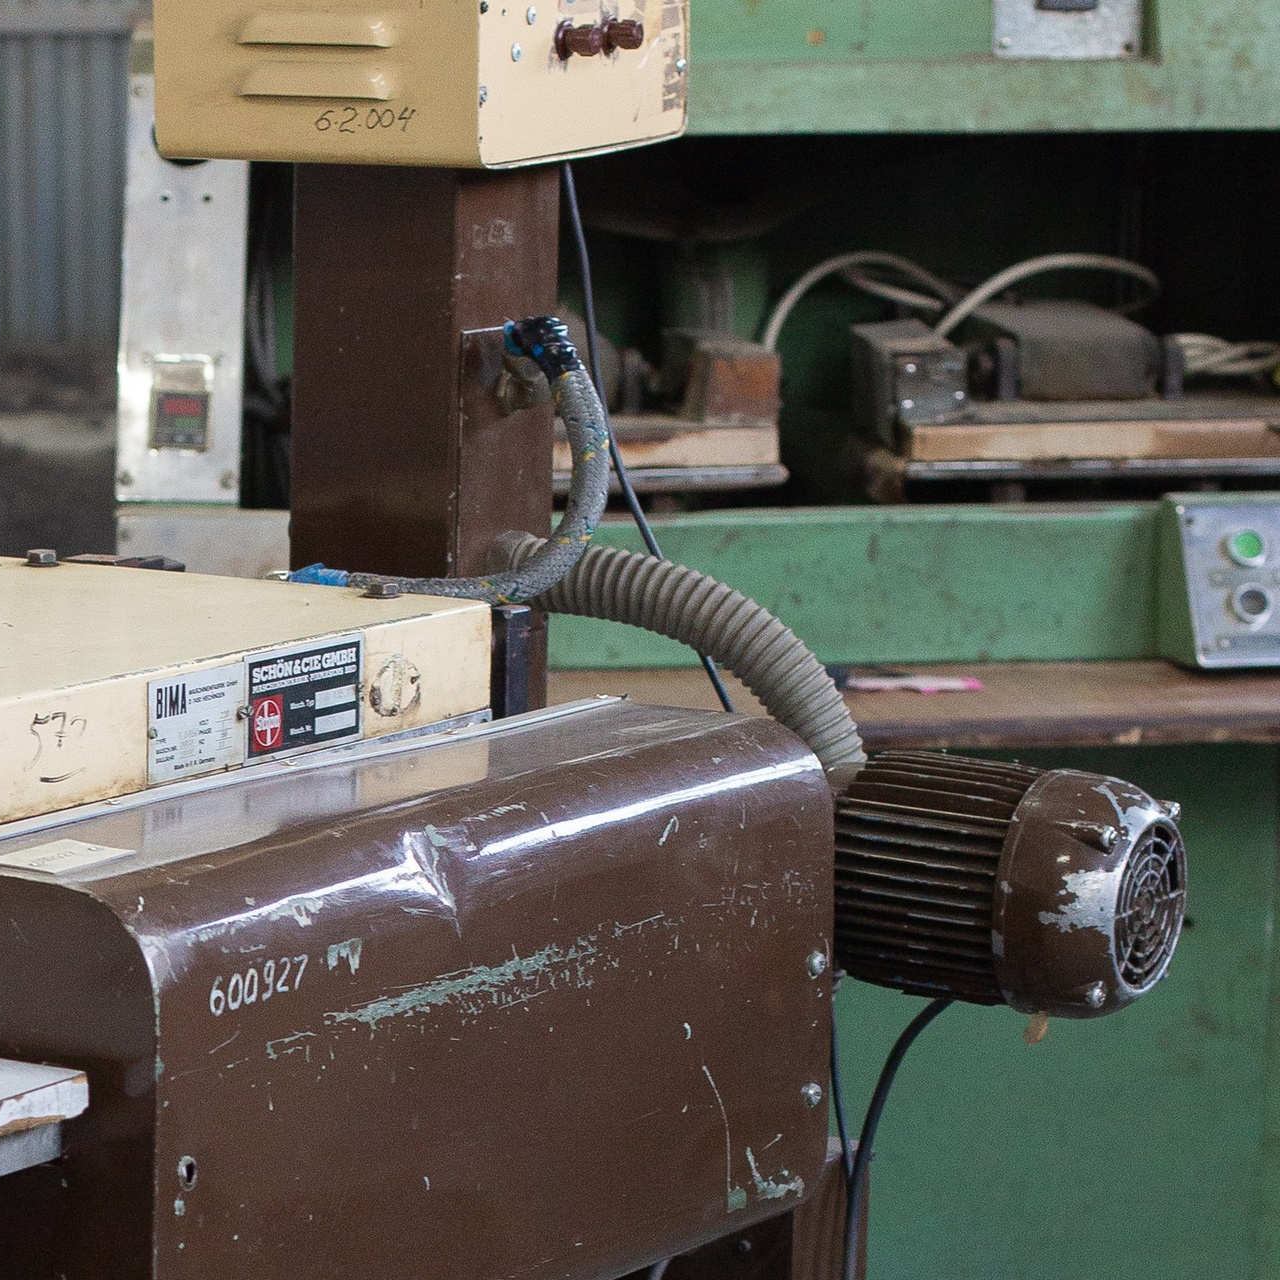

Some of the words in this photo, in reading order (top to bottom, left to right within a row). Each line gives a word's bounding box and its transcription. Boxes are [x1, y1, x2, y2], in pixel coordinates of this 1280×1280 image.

[321, 647, 357, 669] GMBH
[156, 682, 187, 720] BIMA
[209, 953, 309, 1017] 600927
